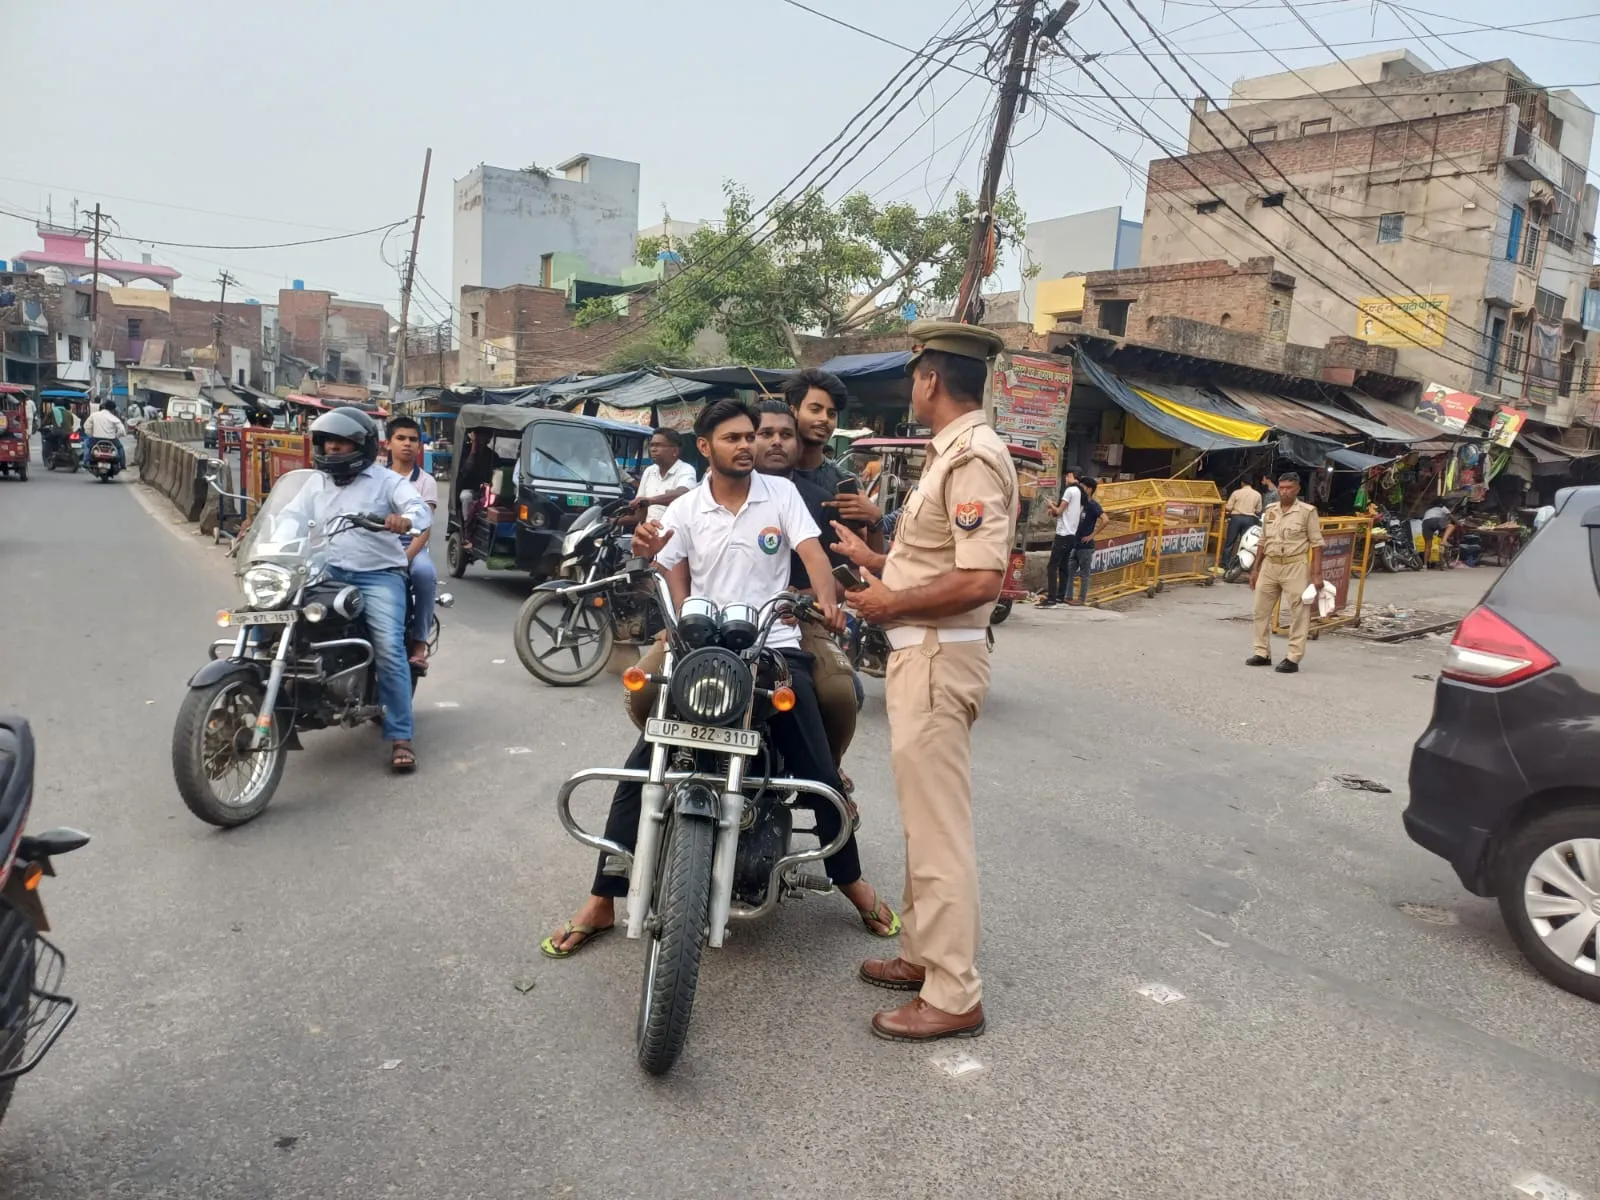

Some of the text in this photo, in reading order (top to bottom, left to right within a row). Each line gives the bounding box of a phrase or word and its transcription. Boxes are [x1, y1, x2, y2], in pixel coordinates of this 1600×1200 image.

[1180, 527, 1206, 553] पुलिस
[1101, 539, 1121, 571] पुलिस
[662, 722, 756, 746] UP 82Z 3101
